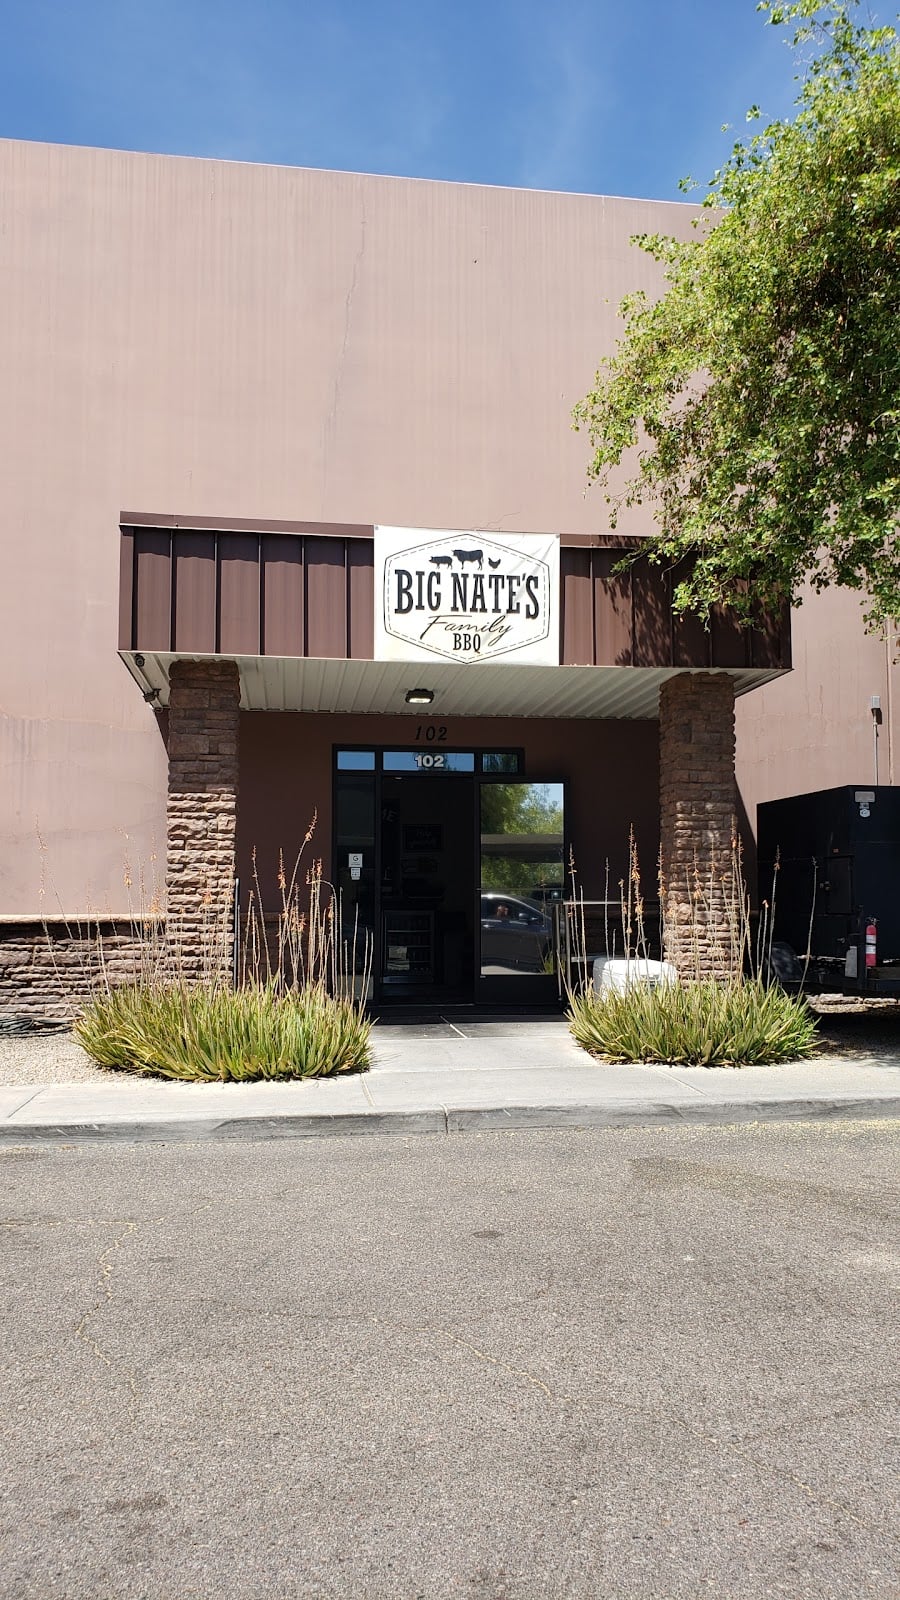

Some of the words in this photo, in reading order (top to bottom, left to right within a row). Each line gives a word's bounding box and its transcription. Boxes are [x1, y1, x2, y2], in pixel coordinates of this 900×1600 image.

[394, 569, 442, 614] BIG
[450, 572, 540, 620] NATE'S
[419, 614, 514, 647] Family
[452, 632, 482, 654] BBQ
[415, 726, 448, 741] 102
[414, 754, 445, 768] 102
